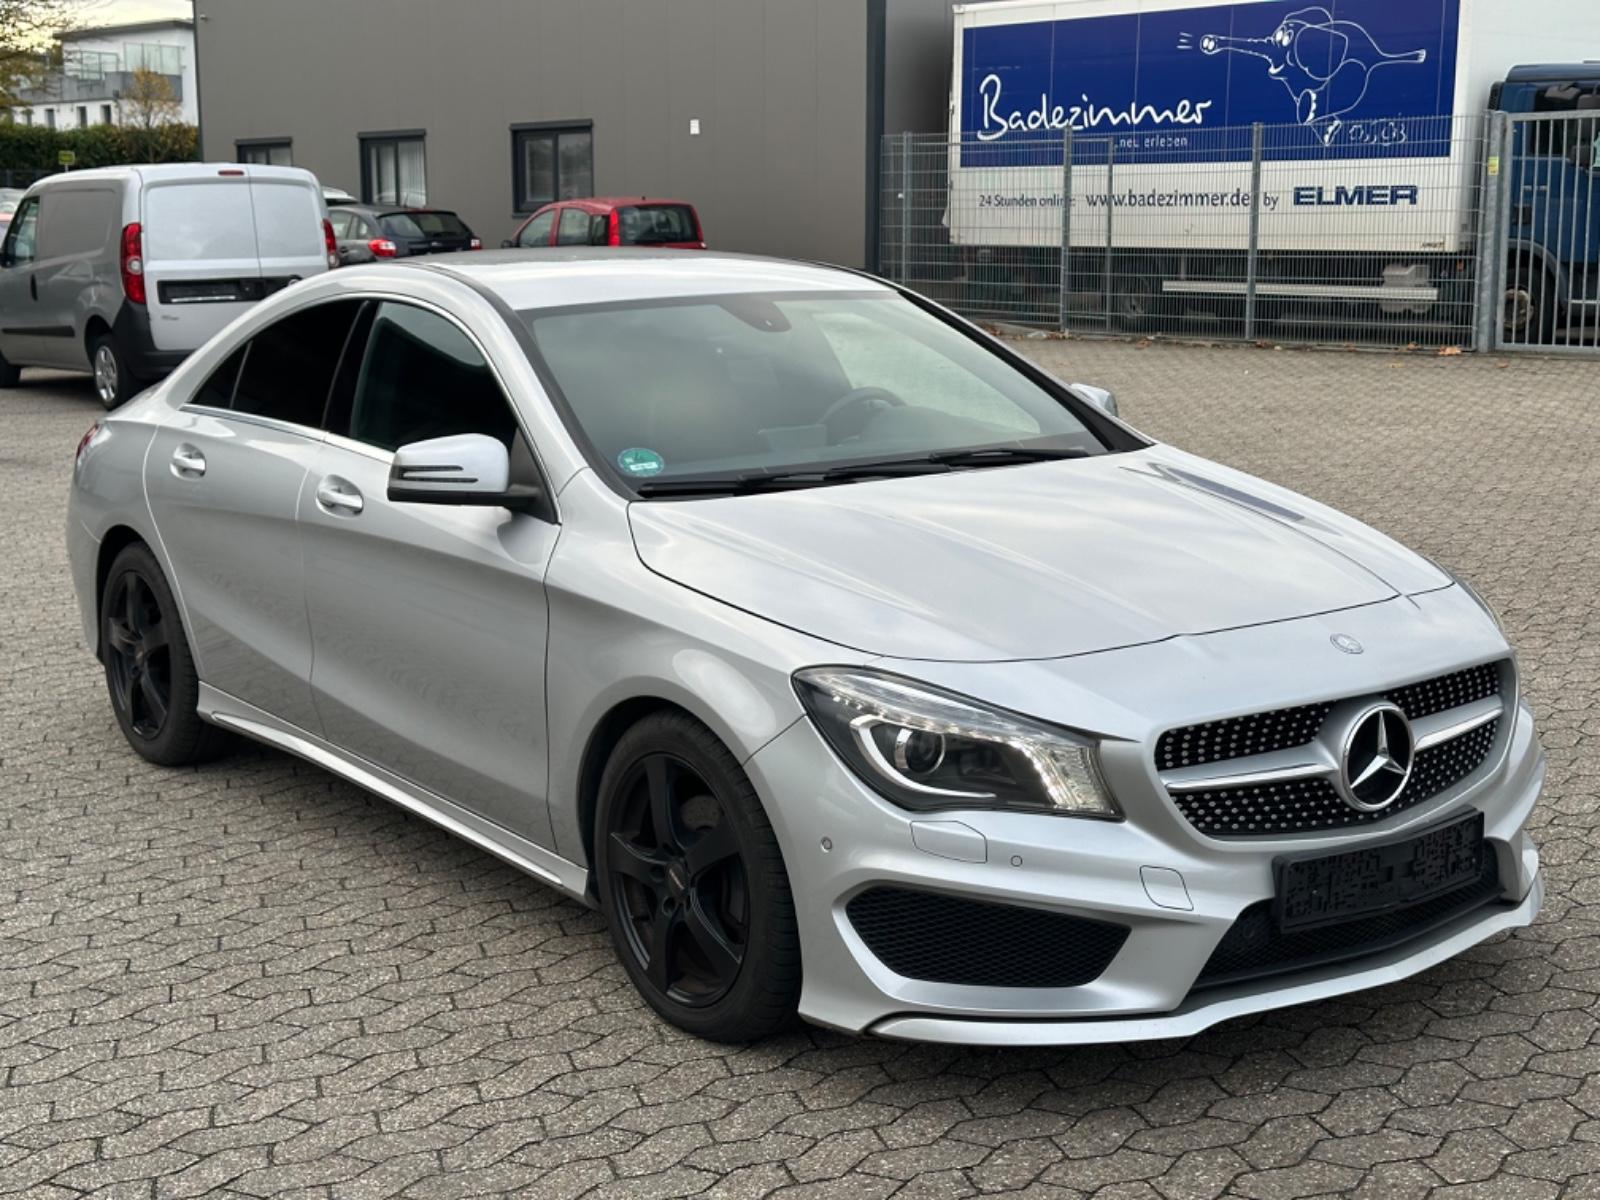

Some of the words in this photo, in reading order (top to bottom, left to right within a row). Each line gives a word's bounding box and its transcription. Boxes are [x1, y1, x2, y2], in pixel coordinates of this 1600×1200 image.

[977, 74, 1212, 141] Badezimmer
[979, 194, 992, 207] 24
[994, 193, 1037, 207] Stunden
[1039, 193, 1076, 207] onlin:
[1085, 188, 1250, 208] www.badezimmer.de
[1263, 192, 1279, 211] by
[1293, 185, 1418, 206] ELMER
